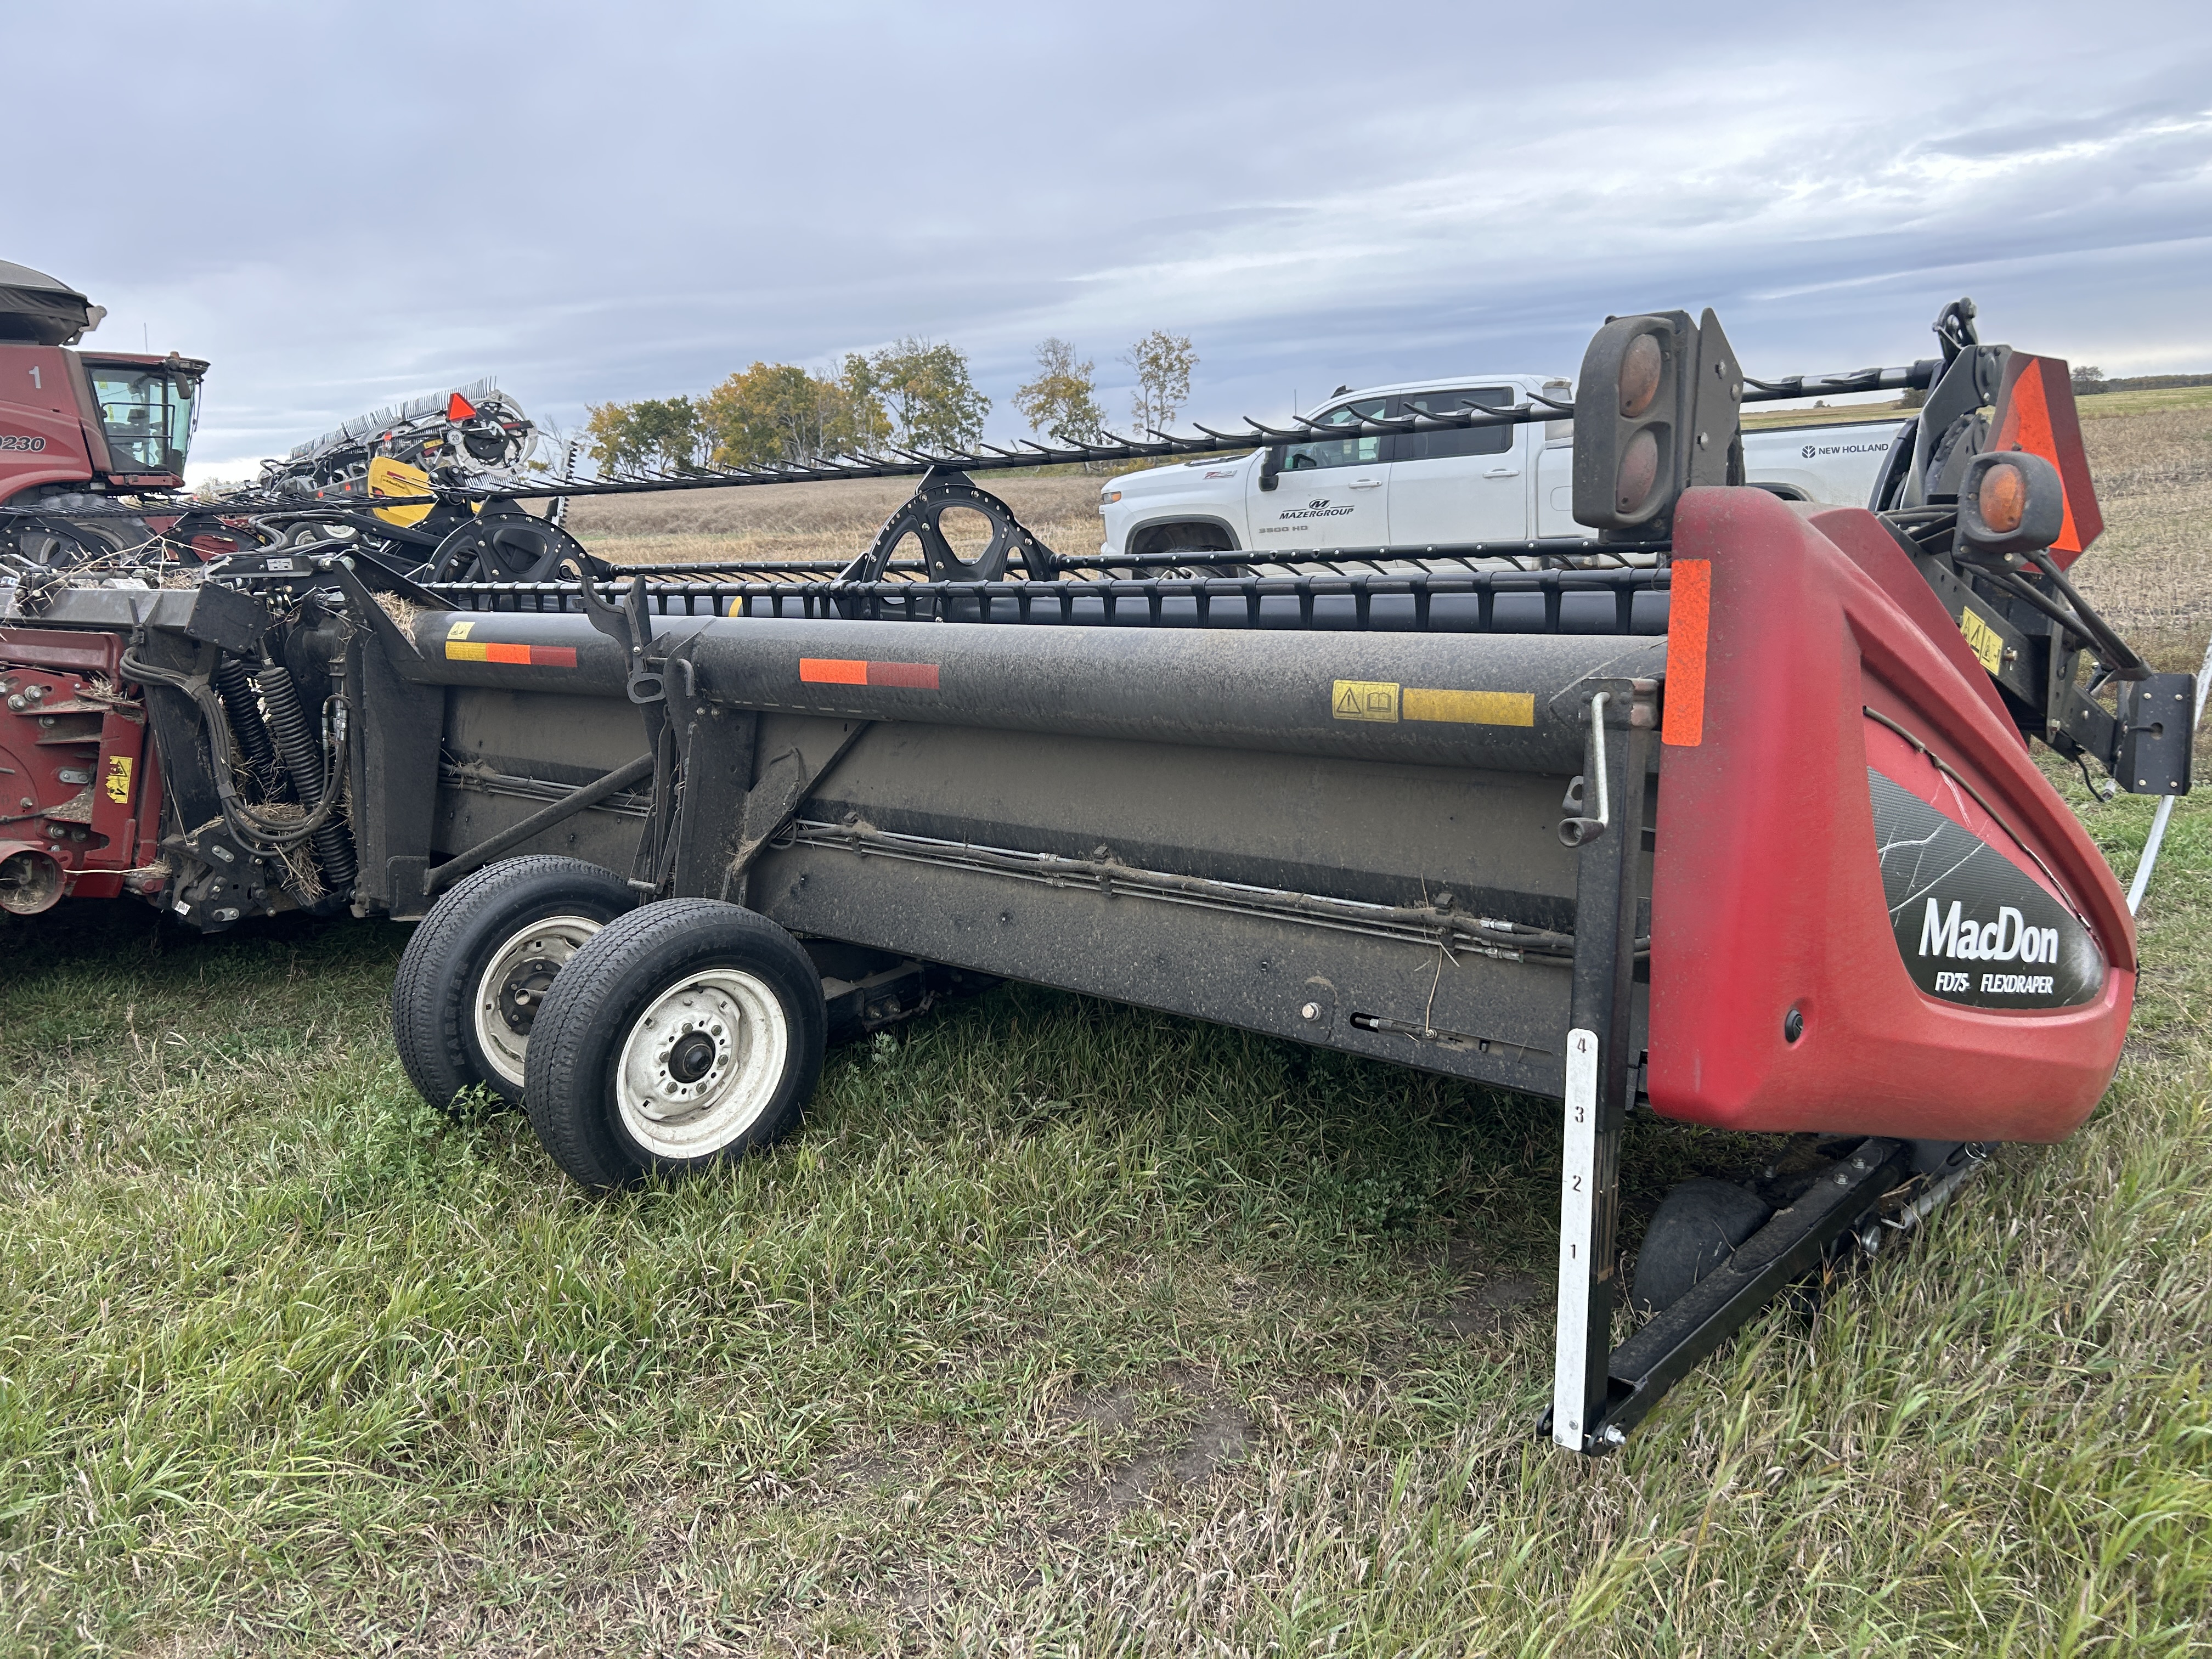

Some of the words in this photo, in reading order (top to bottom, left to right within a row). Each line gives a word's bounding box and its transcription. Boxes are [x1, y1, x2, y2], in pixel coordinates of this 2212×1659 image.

[29, 365, 41, 389] 1
[0, 435, 46, 452] 230
[1818, 446, 1841, 455] NEW
[1842, 443, 1889, 453] HOLLAND
[1279, 508, 1354, 520] MAZERGROUP
[1918, 897, 2059, 964] MacDon
[1980, 973, 2053, 994] FLEXDRAPER
[1577, 1037, 1587, 1053] 4
[1575, 1106, 1584, 1123] 3
[1572, 1175, 1582, 1192] 2
[1570, 1244, 1576, 1260] 1
